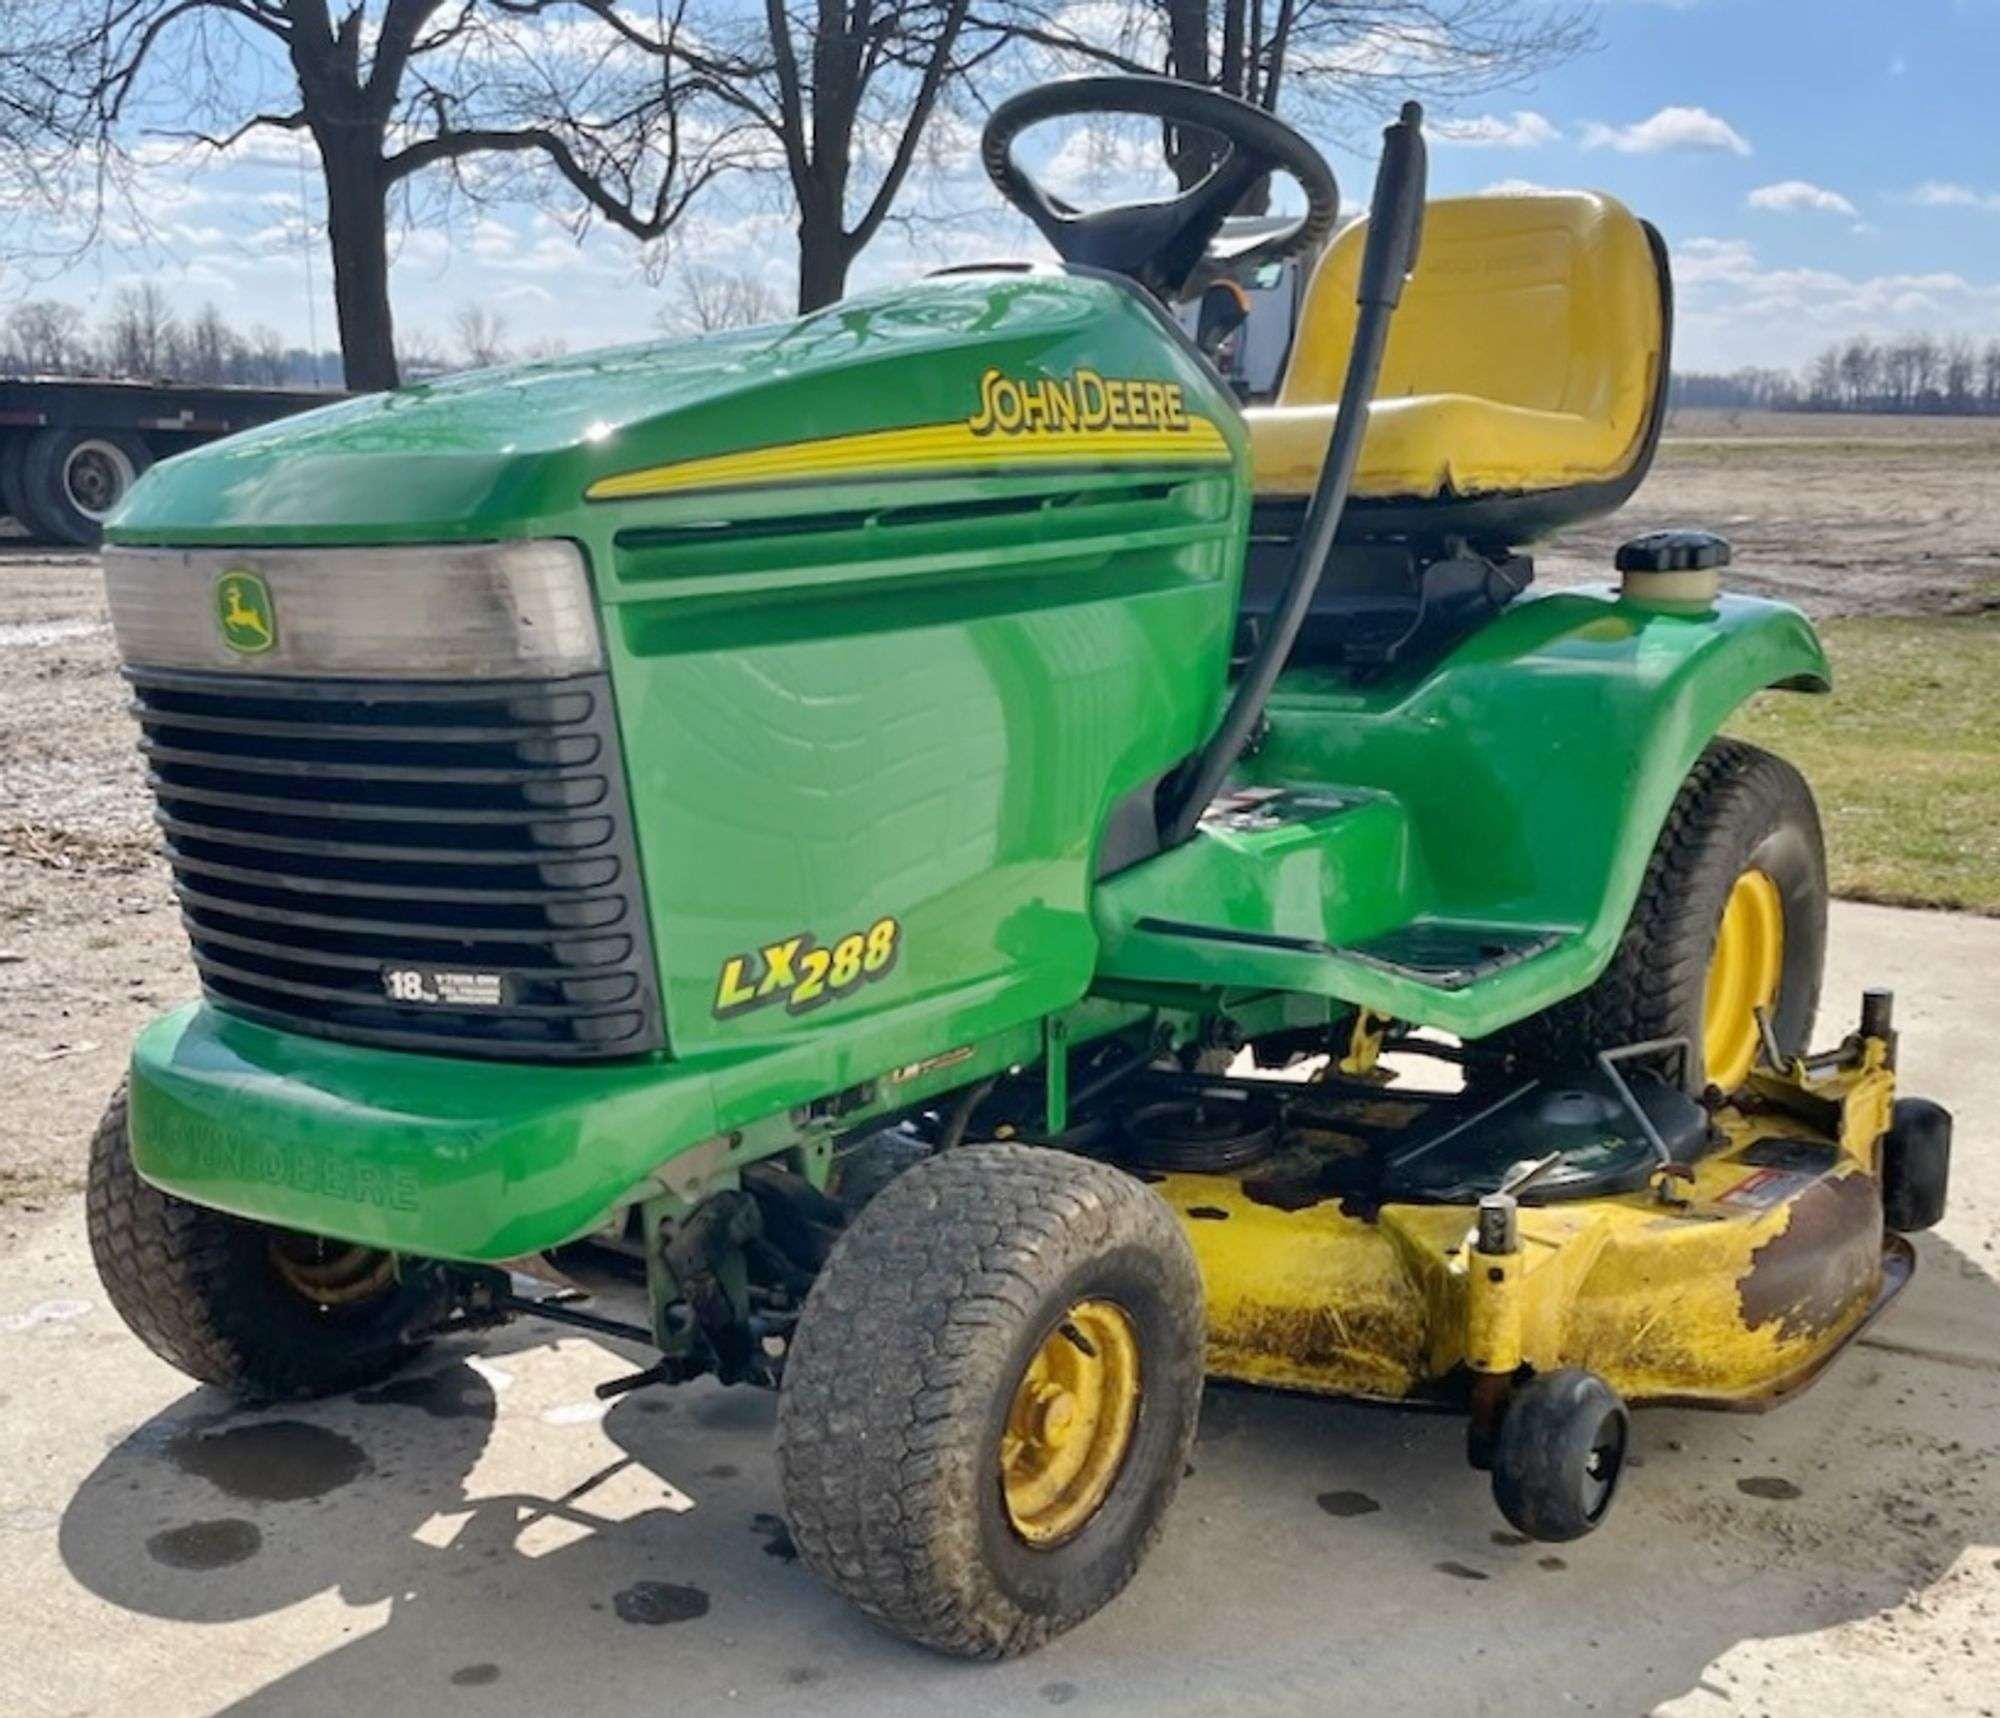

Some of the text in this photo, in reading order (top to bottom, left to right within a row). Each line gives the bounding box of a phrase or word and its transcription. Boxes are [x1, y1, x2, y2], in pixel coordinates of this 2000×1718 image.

[969, 367, 1189, 436] JOHN DEERE
[389, 970, 423, 1001] 18
[712, 916, 900, 1020] LX288
